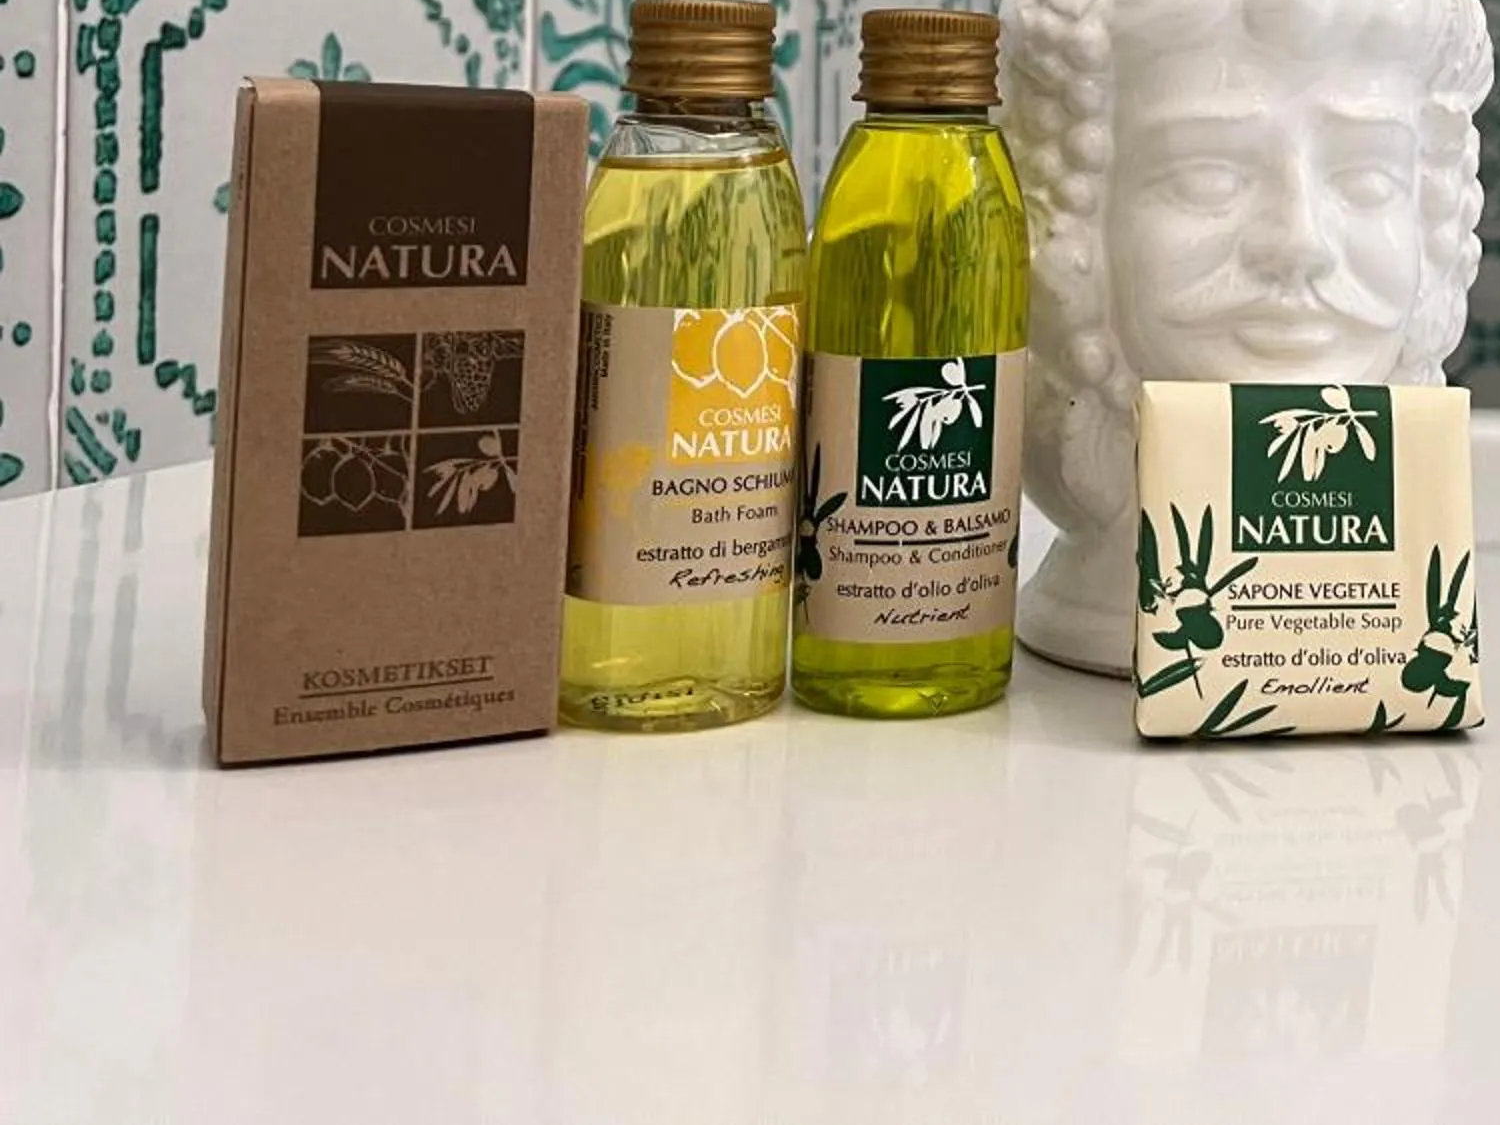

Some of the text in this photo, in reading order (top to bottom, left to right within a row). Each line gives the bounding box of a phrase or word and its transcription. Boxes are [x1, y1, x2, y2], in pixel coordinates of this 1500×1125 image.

[368, 215, 477, 236] COSMESI
[320, 244, 518, 282] NATURA
[699, 406, 781, 426] COSMESI
[671, 426, 792, 459] NATURA
[885, 451, 972, 472] COSMESI
[652, 477, 727, 496] BAGNO
[860, 472, 988, 503] NATURA
[1271, 491, 1353, 508] COSMESI
[691, 504, 778, 524] Bath Foam
[827, 508, 1011, 536] SHAMPOO & BALSAMO
[1237, 514, 1388, 545] NATURA
[636, 545, 704, 562] estratto
[709, 541, 726, 559] di
[829, 539, 1008, 568] Shampoo & Conditioner
[668, 564, 786, 588] Refreshing
[837, 574, 1000, 600] estratto d'olio d'oliva
[1228, 582, 1401, 600] SAPONE VEGETALE
[873, 603, 971, 625] Nutrient
[1226, 612, 1403, 635] Pure Vegetable Soap
[1222, 647, 1407, 668] estratto d'olio d'oliva
[302, 655, 494, 690] KOSMETIKSET
[1261, 677, 1370, 695] Emollient
[273, 688, 516, 725] Ensemble Cosmétiques
